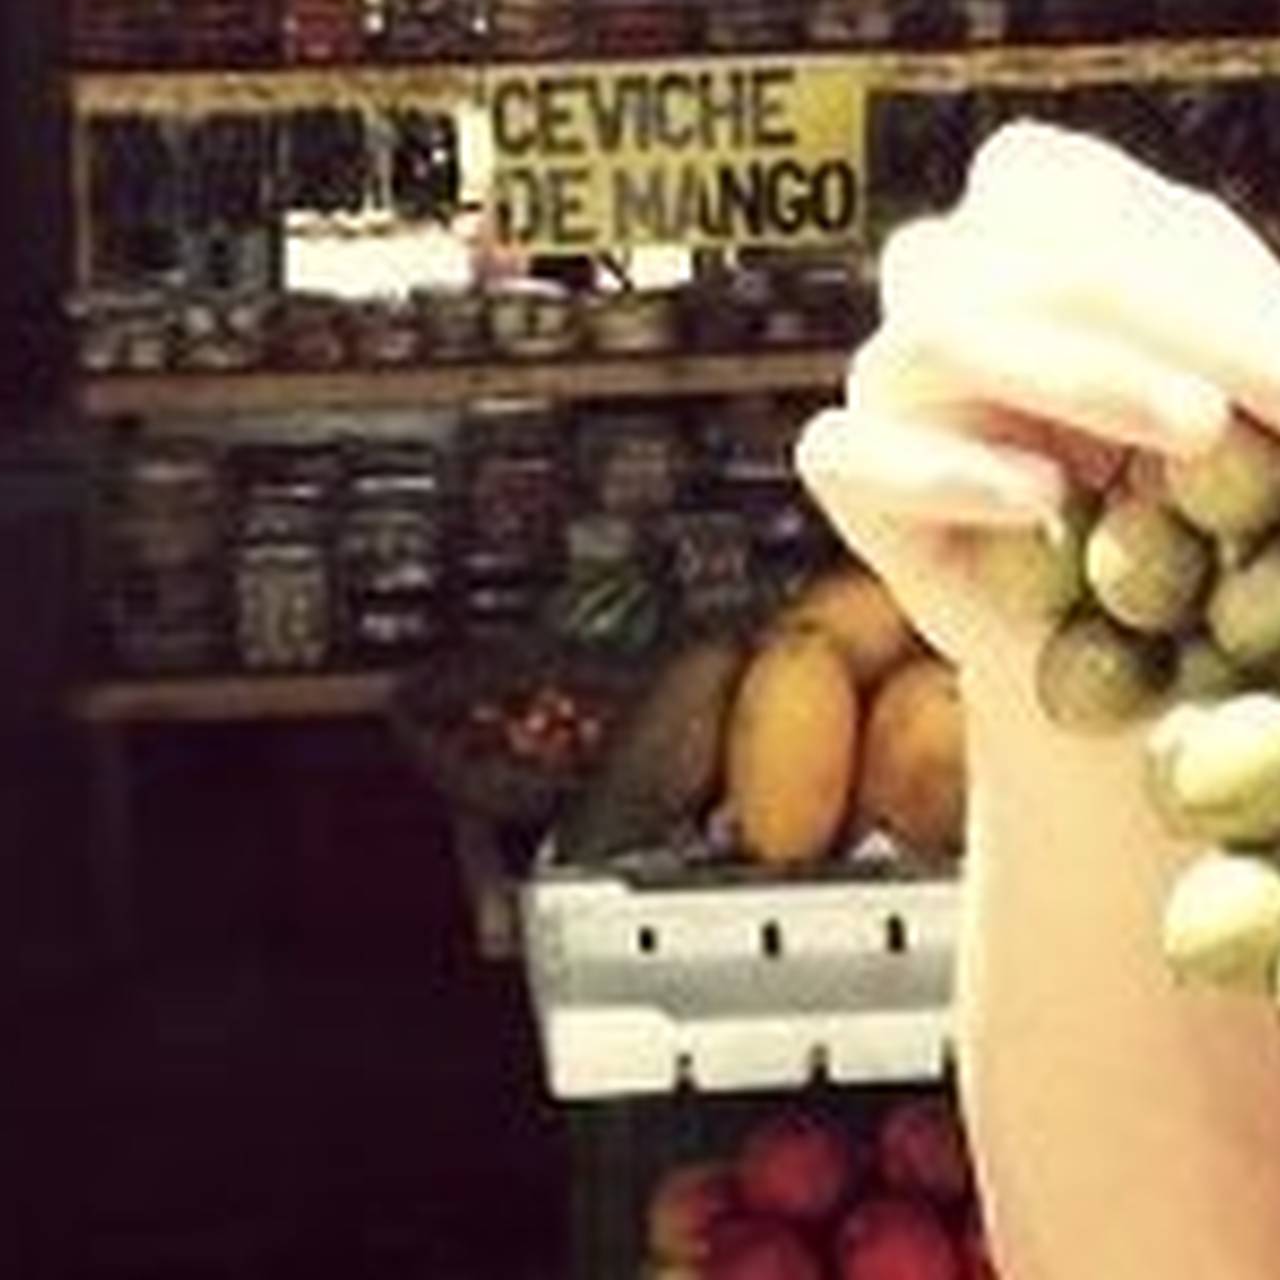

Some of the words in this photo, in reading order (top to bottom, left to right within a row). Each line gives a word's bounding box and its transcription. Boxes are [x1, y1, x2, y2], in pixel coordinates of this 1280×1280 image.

[492, 68, 798, 157] CEVICHE
[494, 167, 596, 246] DE
[613, 158, 858, 243] MANGO
